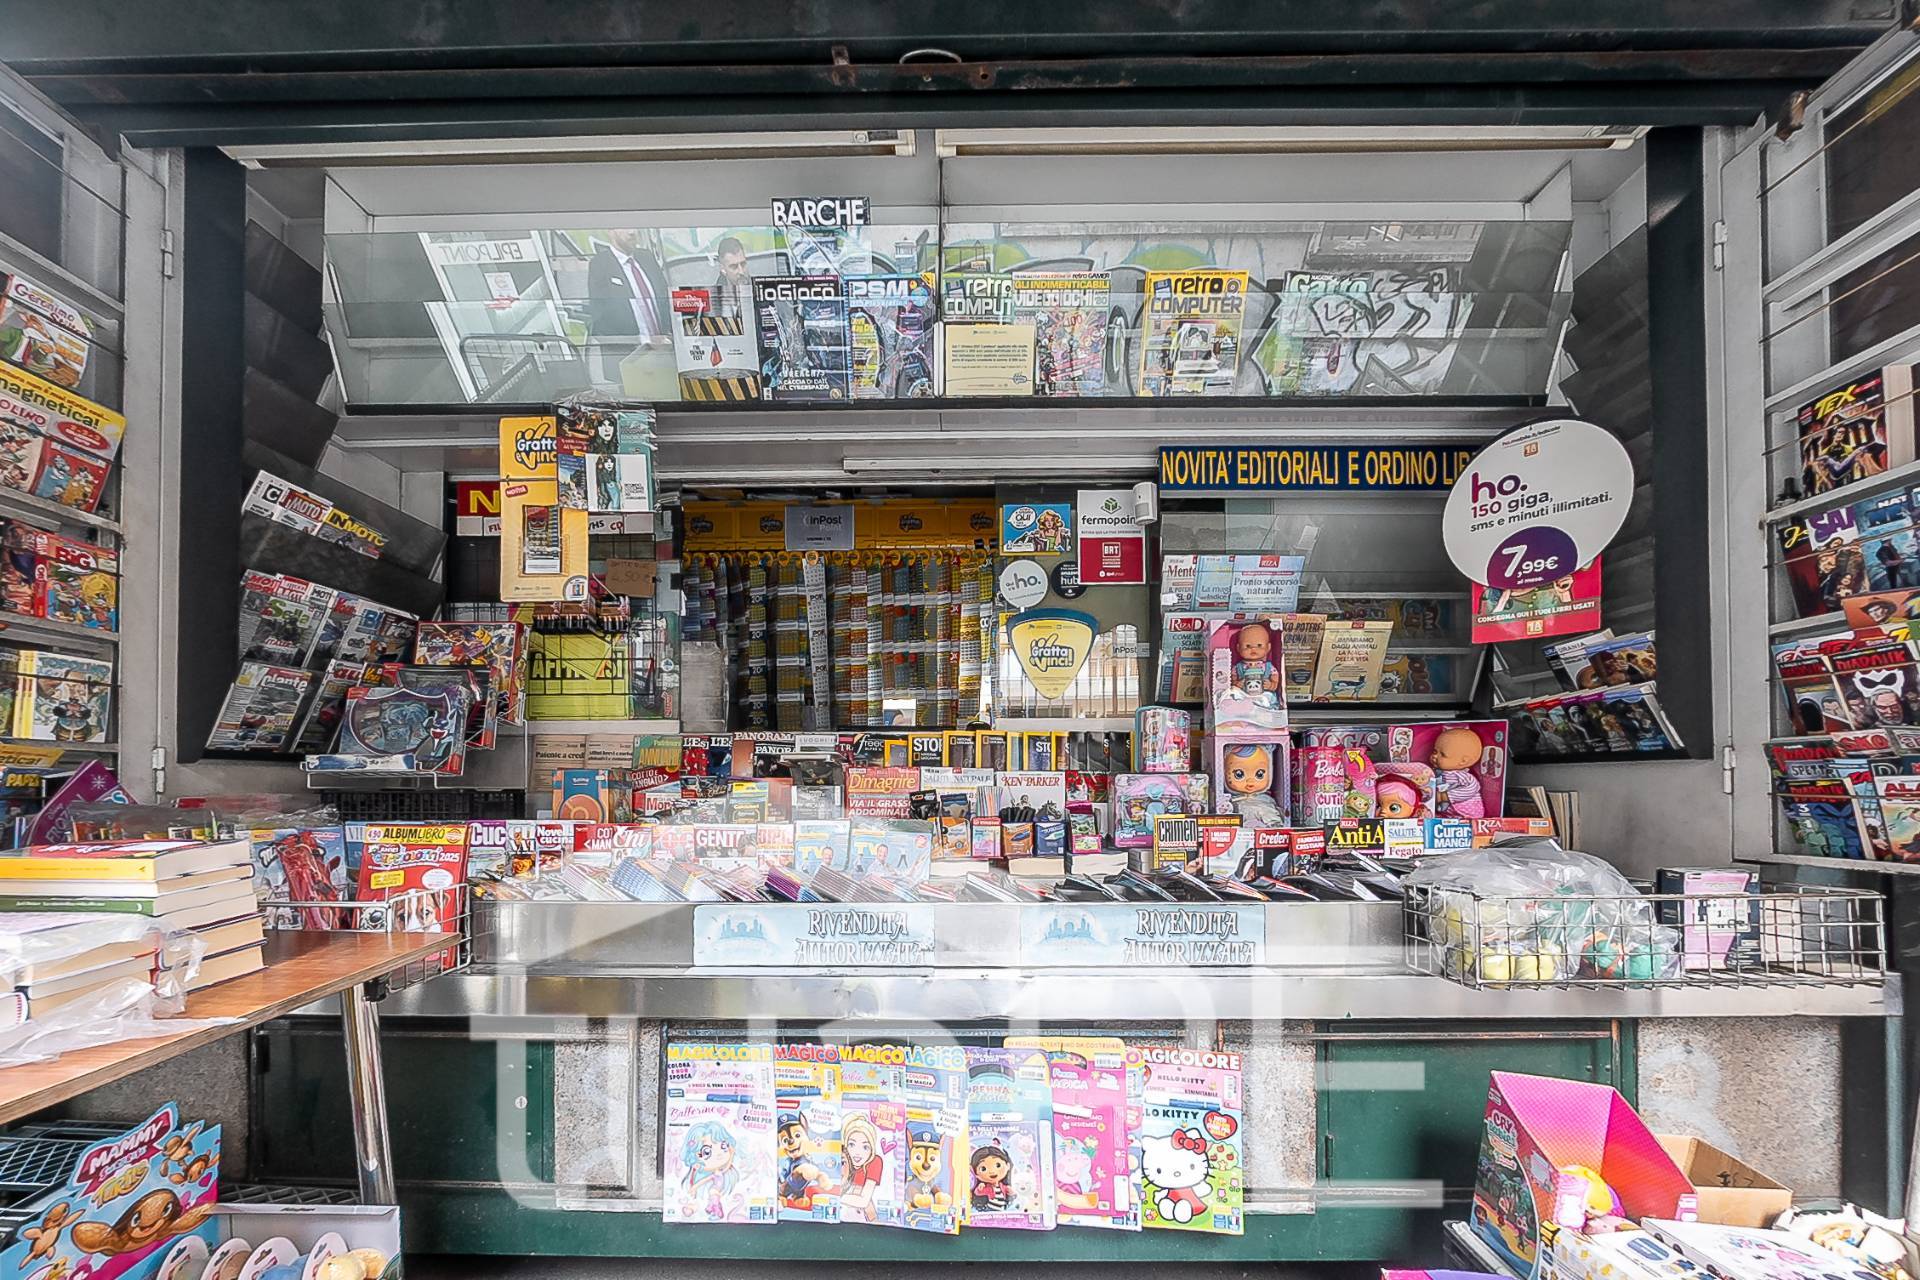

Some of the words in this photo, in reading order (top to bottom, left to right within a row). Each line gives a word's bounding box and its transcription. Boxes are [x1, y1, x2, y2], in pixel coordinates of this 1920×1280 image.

[772, 200, 866, 226] BARCHE
[852, 281, 909, 298] PSM
[966, 278, 1012, 296] retro
[1015, 281, 1029, 289] GLI
[1030, 281, 1109, 289] INDIMENTICABILI
[1174, 276, 1223, 294] retro
[14, 281, 75, 323] Geronimo
[945, 298, 1012, 315] COMPUT
[1150, 296, 1243, 314] COMPUTER
[1815, 385, 1857, 421] TEX
[0, 399, 46, 428] OLINO
[1162, 450, 1232, 485] NOVITA'
[1237, 450, 1339, 485] EDITORIALI
[1348, 450, 1359, 485] E
[1365, 450, 1437, 485] ORDINO
[1443, 450, 1476, 485] LIB
[1471, 471, 1527, 503] ho.
[1470, 519, 1495, 532] sms
[1497, 517, 1505, 527] e
[1508, 507, 1549, 525] minuti
[1552, 491, 1613, 514] illimitati.
[1471, 501, 1502, 519] 150
[1507, 491, 1553, 513] giga,
[1015, 514, 1031, 522] QUI
[1082, 514, 1136, 526] fermopoin
[488, 524, 501, 533] FIL
[1104, 545, 1119, 555] BRT
[1262, 559, 1278, 568] RIZA
[1502, 544, 1559, 578] 7,99€
[1013, 573, 1041, 589] ho.
[1234, 577, 1262, 586] Pronto
[1264, 577, 1299, 586] soccorso
[1247, 585, 1284, 595] naturale
[1573, 600, 1595, 612] USATI
[1032, 646, 1068, 657] Gratta
[755, 745, 797, 754] PANOR
[914, 737, 942, 753] STO
[1315, 759, 1344, 778] Barbi
[849, 774, 916, 793] Dimagrire
[1001, 776, 1023, 787] KEN
[1024, 776, 1060, 787] PARKER
[849, 800, 865, 808] VIA
[866, 800, 875, 808] IL
[877, 800, 911, 808] GRASS
[1316, 805, 1343, 821] REVE
[44, 805, 73, 844] FROZ
[1158, 819, 1198, 842] CRIMEN
[1434, 823, 1471, 838] Curar
[1478, 818, 1502, 834] RIZA
[471, 823, 506, 847] Cuc
[613, 826, 646, 849] Chi
[1329, 824, 1385, 846] AntiA
[440, 852, 460, 861] 2025
[1388, 846, 1422, 857] Fegato
[808, 909, 909, 939] RIVENDITA
[1136, 908, 1238, 939] RIVENDITA
[796, 938, 930, 965] AUTORIZZATA
[1124, 937, 1256, 965] AUTORIZZATA
[775, 1046, 838, 1062] MAGICO
[839, 1047, 905, 1064] MAGICO
[1144, 1048, 1240, 1070] AGICOLORE
[1182, 1076, 1206, 1085] KITTY
[1162, 1108, 1199, 1120] KITTY
[88, 1120, 164, 1175] MAMMY
